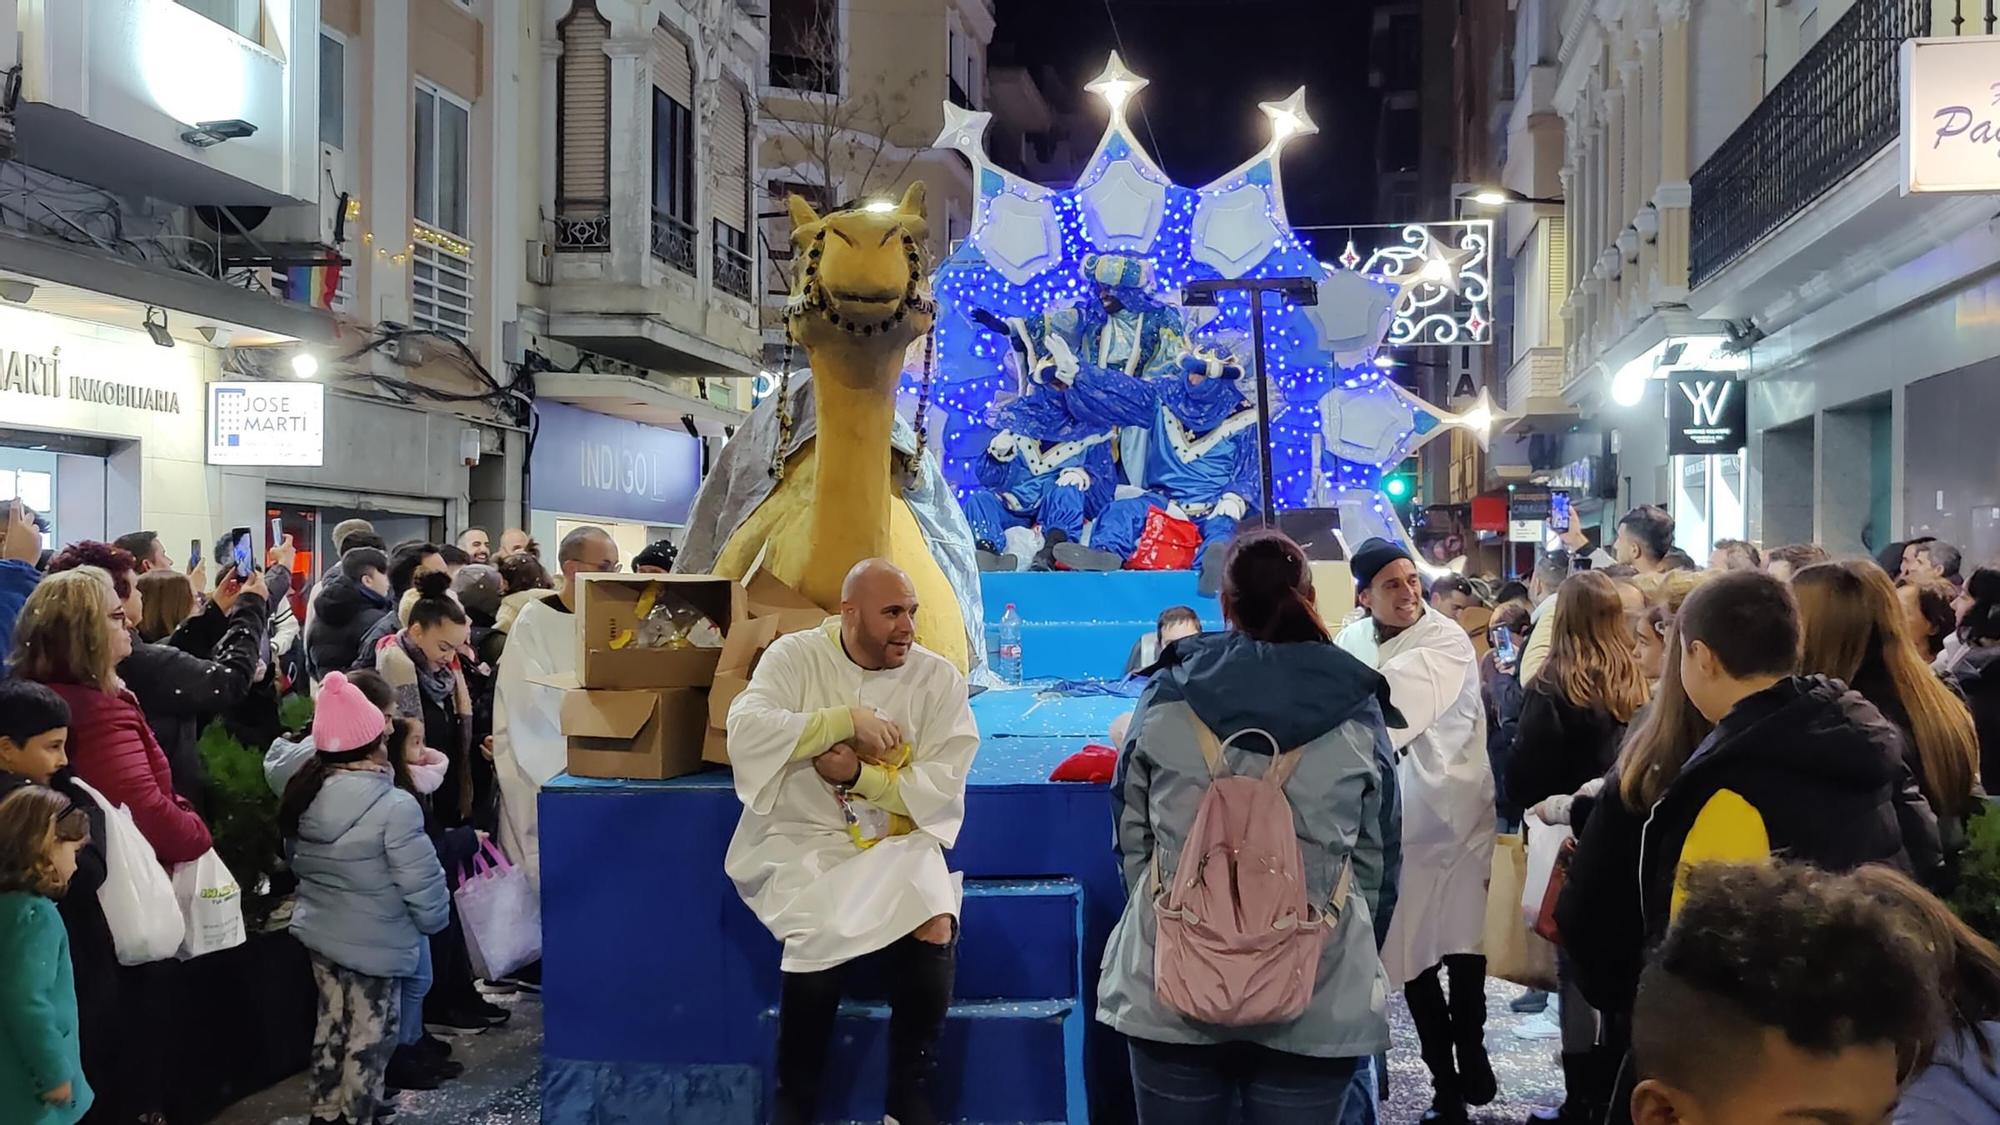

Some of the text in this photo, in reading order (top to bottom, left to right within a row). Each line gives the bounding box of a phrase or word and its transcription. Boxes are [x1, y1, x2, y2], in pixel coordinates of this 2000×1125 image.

[1933, 105, 2000, 158] Pa
[69, 376, 180, 414] INMOBILIARIA
[243, 397, 290, 413] JOSE
[243, 411, 306, 432] MARTÍ
[580, 440, 647, 495] INDIGO
